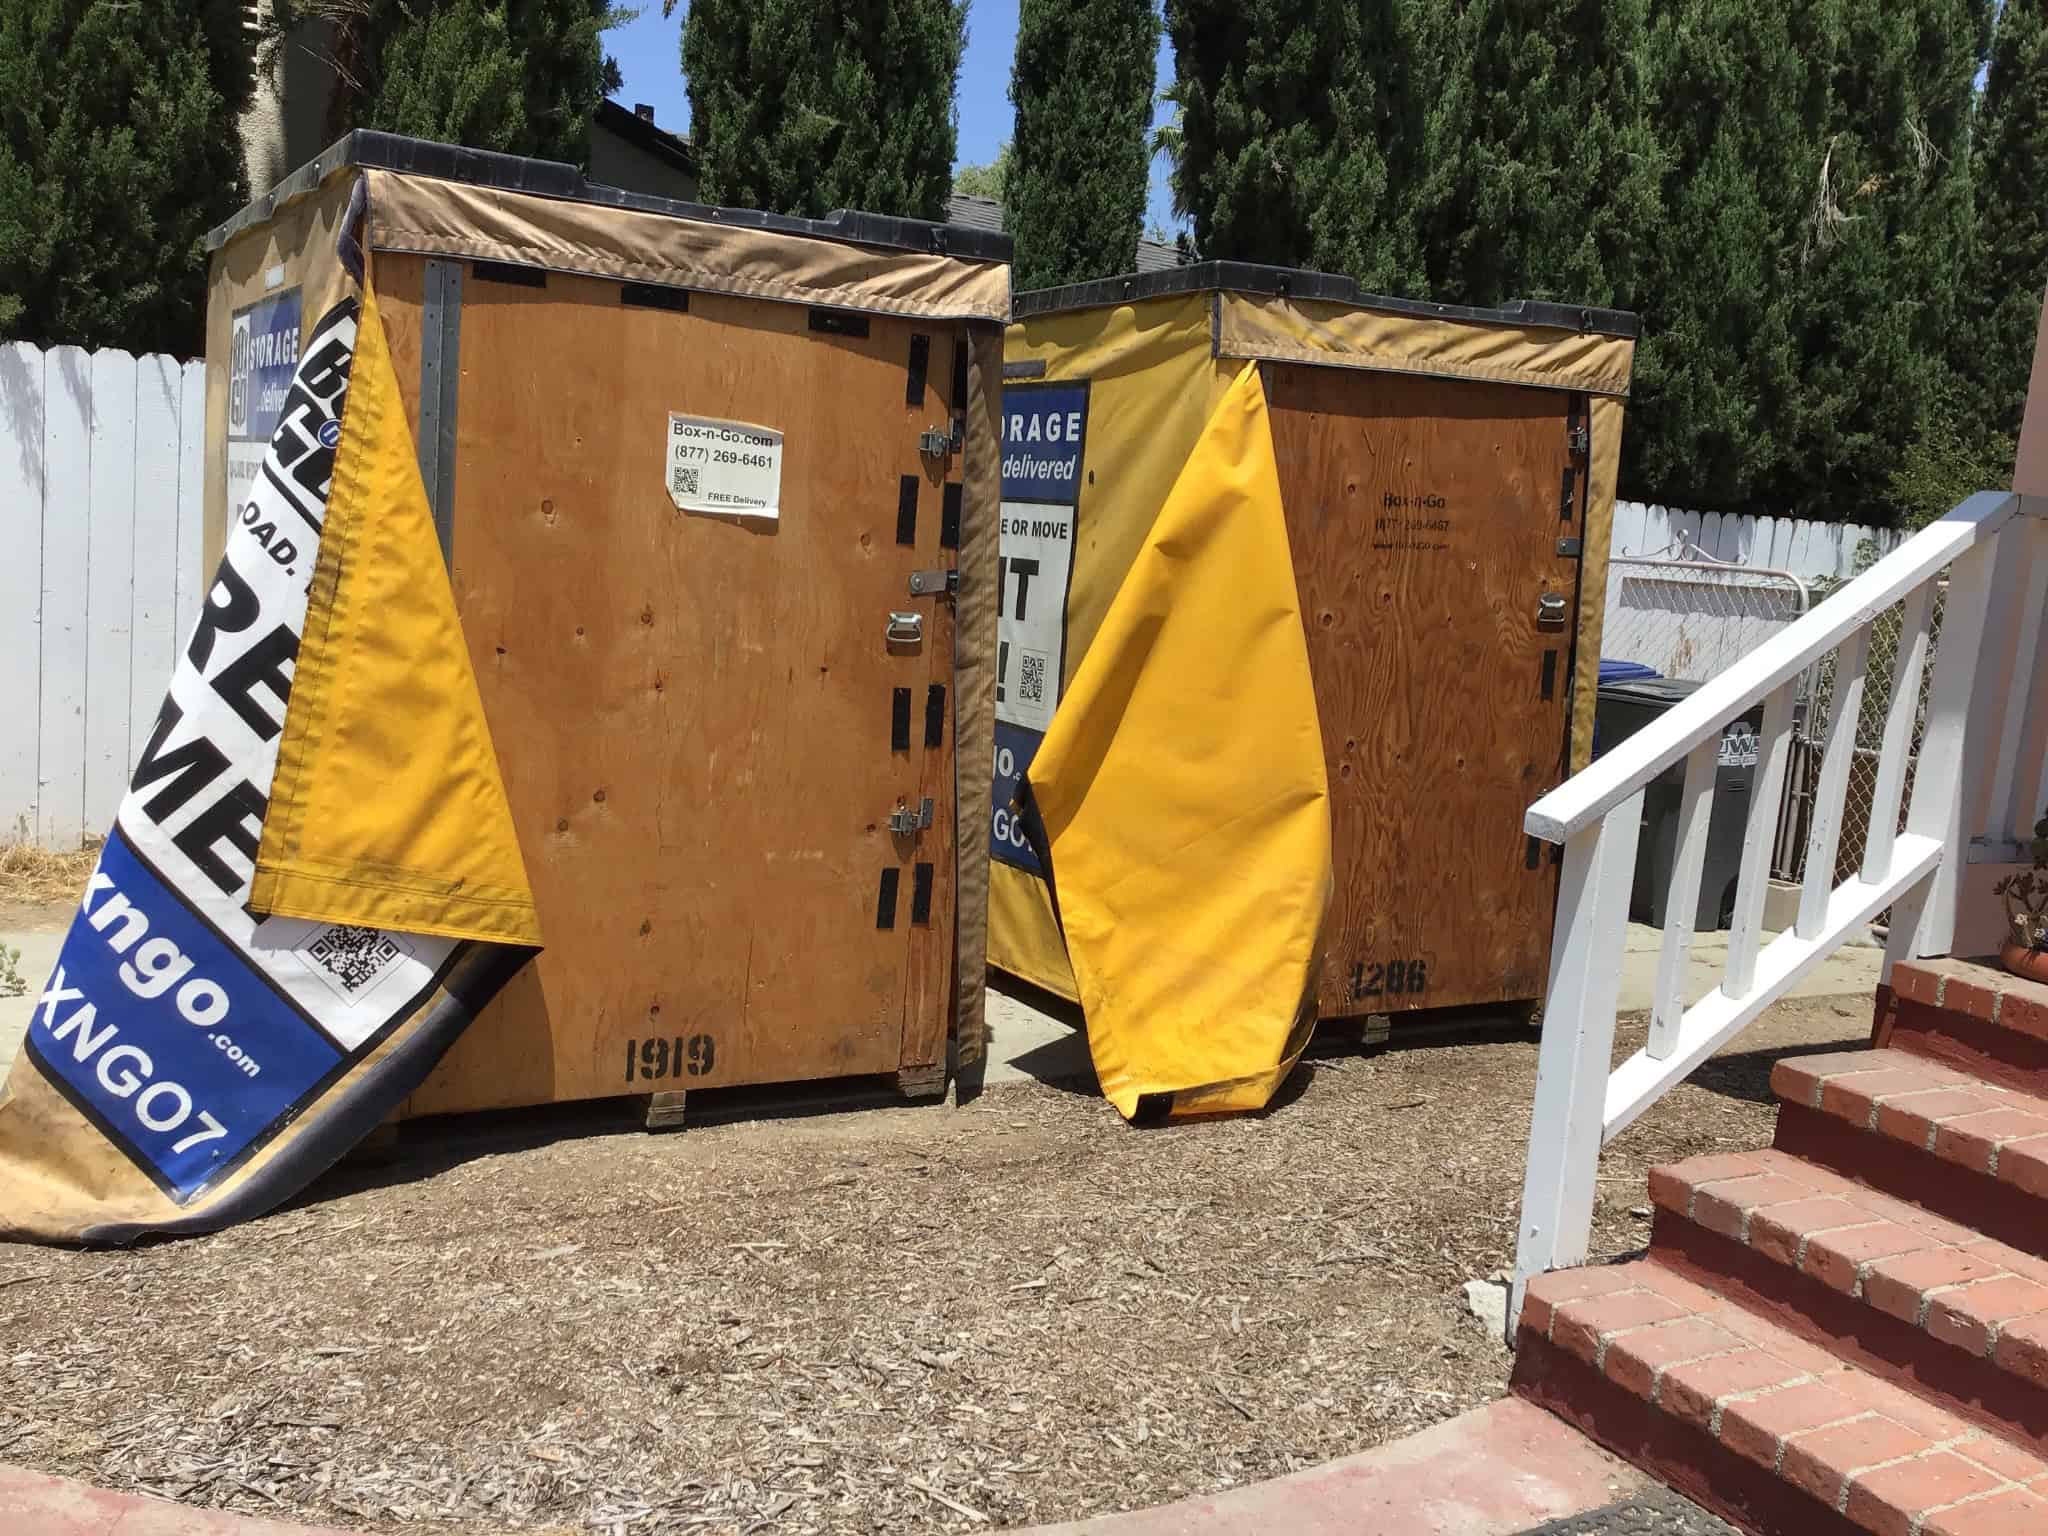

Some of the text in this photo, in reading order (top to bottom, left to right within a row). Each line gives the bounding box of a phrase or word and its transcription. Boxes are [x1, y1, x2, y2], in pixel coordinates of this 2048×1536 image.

[249, 327, 299, 371] STORAGE
[673, 422, 774, 448] Box-n-Go.com
[1001, 412, 1081, 442] RAGE
[675, 444, 773, 469] (877) 269-6461
[1002, 453, 1076, 481] delivered
[708, 492, 767, 508] FREE Delivery
[1012, 519, 1029, 537] OR
[1032, 520, 1068, 540] MOVE
[625, 1034, 715, 1082] 1919
